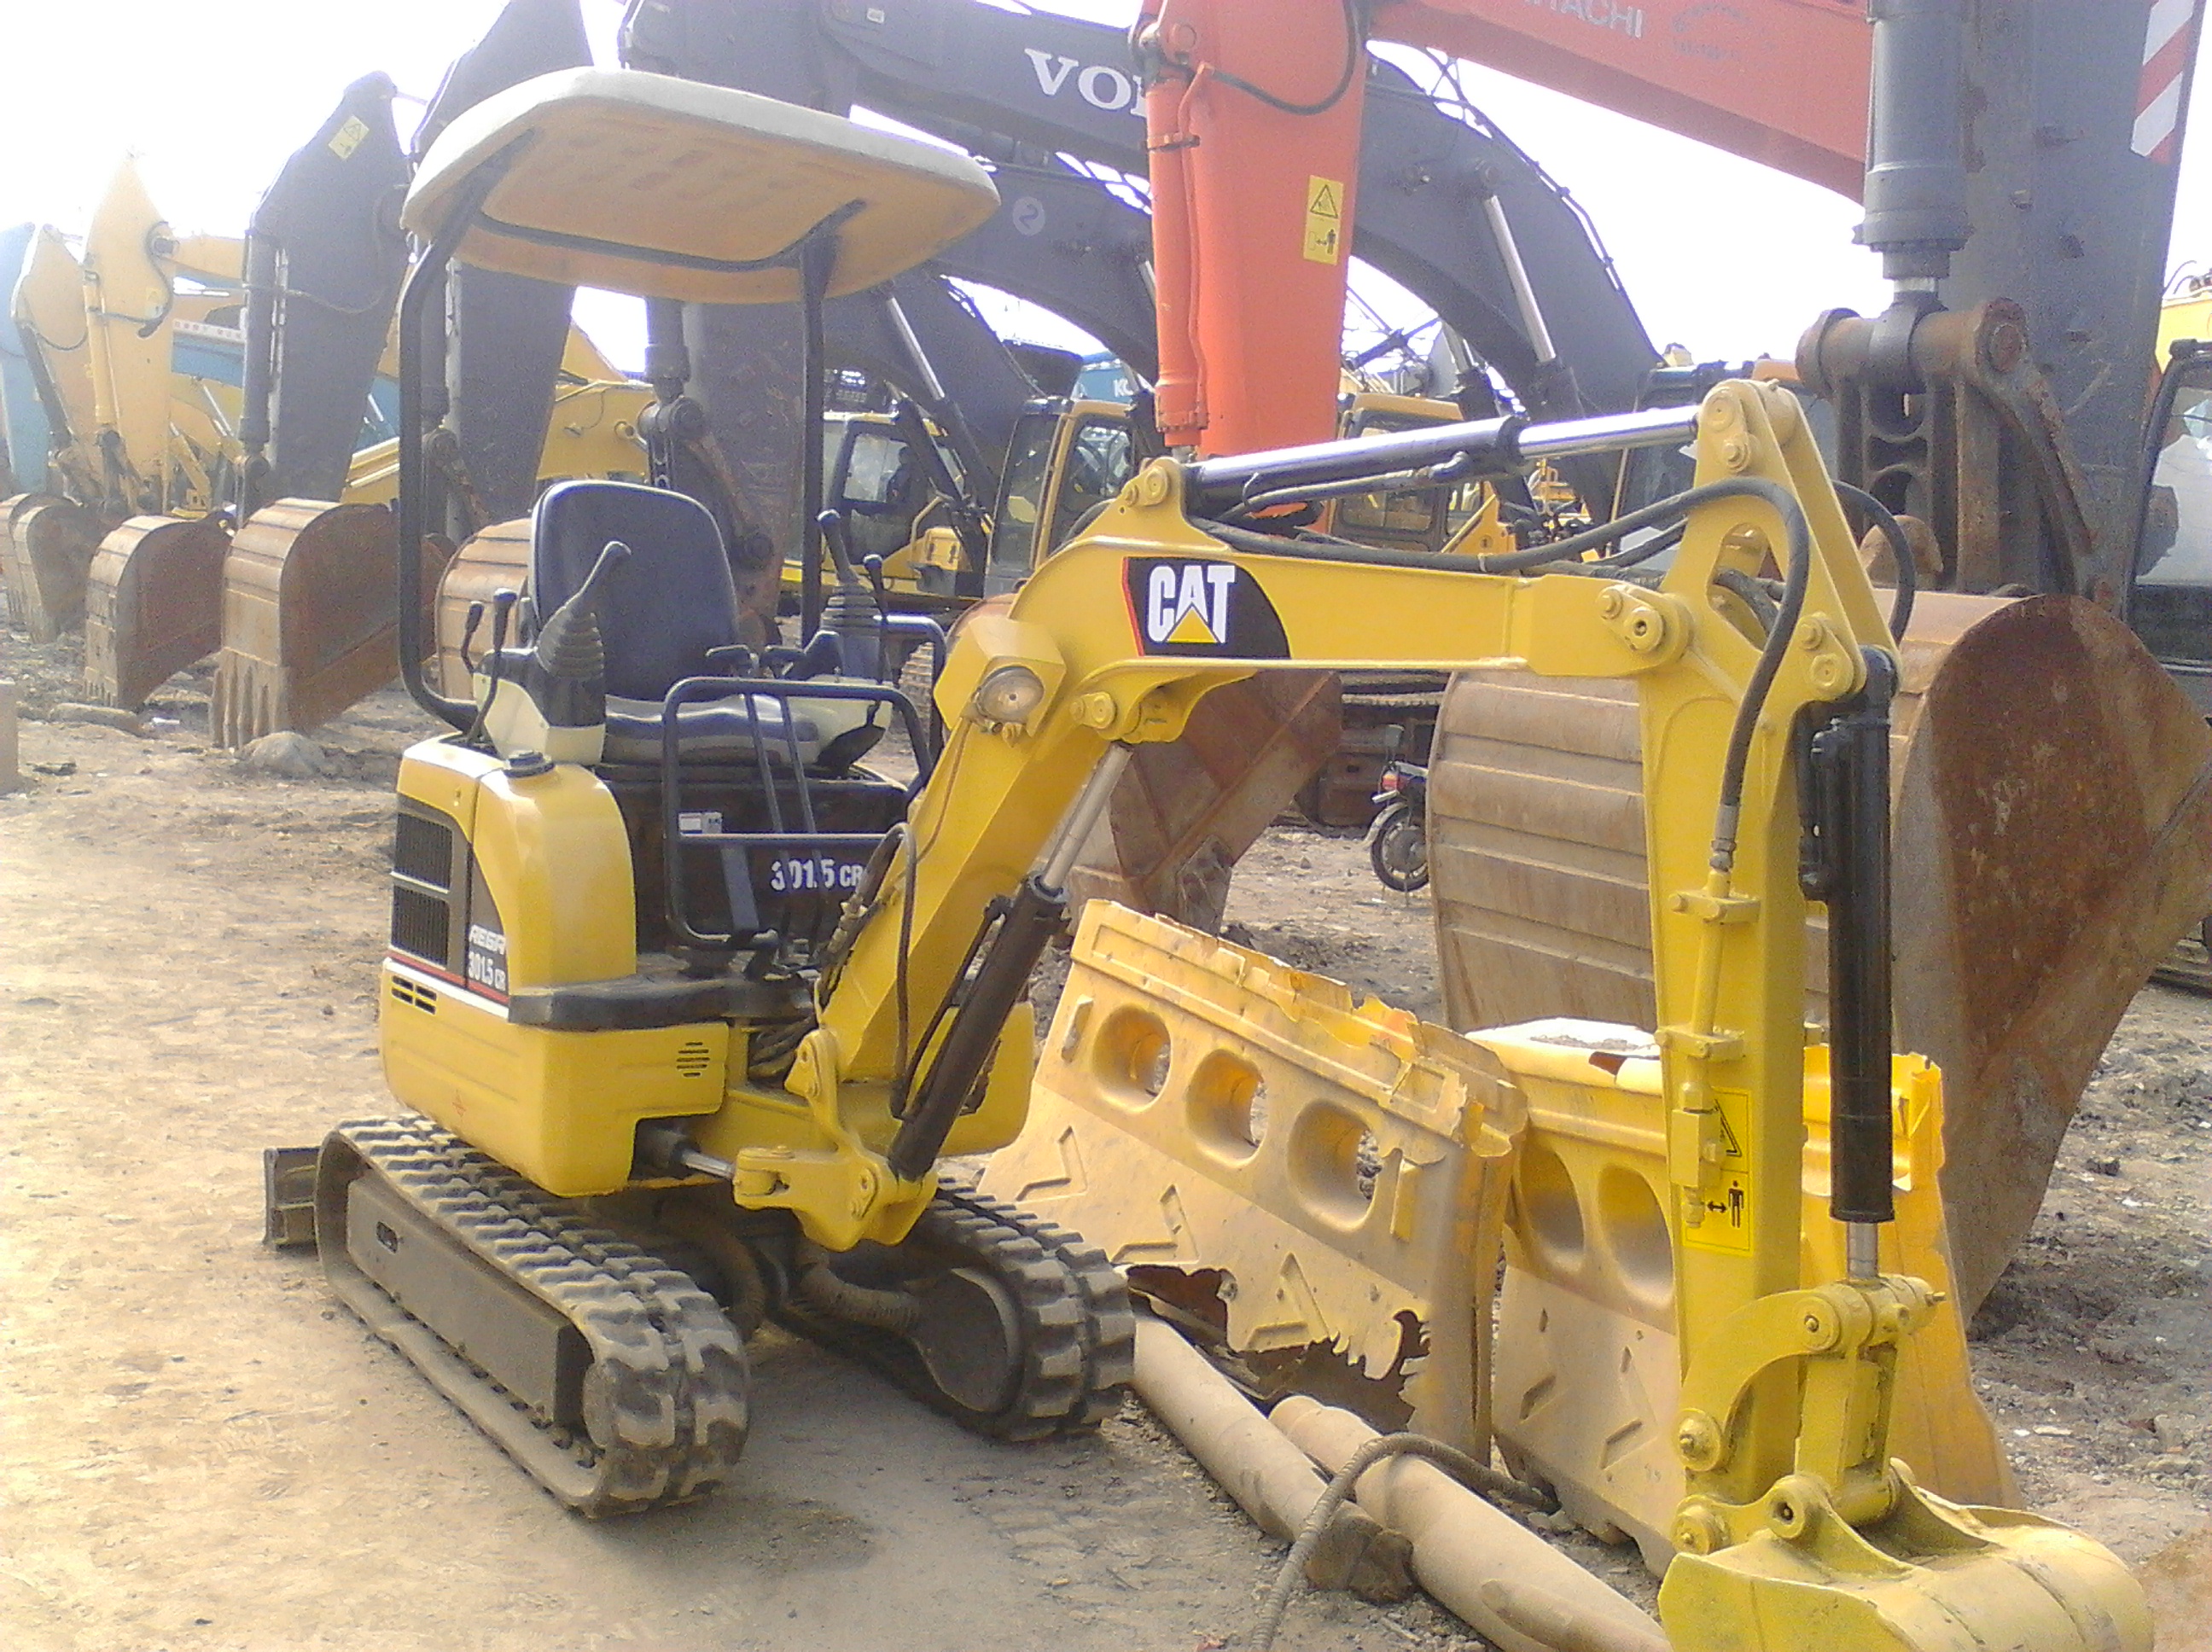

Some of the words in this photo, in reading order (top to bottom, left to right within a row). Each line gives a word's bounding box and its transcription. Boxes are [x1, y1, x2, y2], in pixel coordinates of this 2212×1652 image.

[1523, 0, 1644, 38] ACHI
[1148, 565, 1236, 644] CAT
[839, 864, 867, 888] CR
